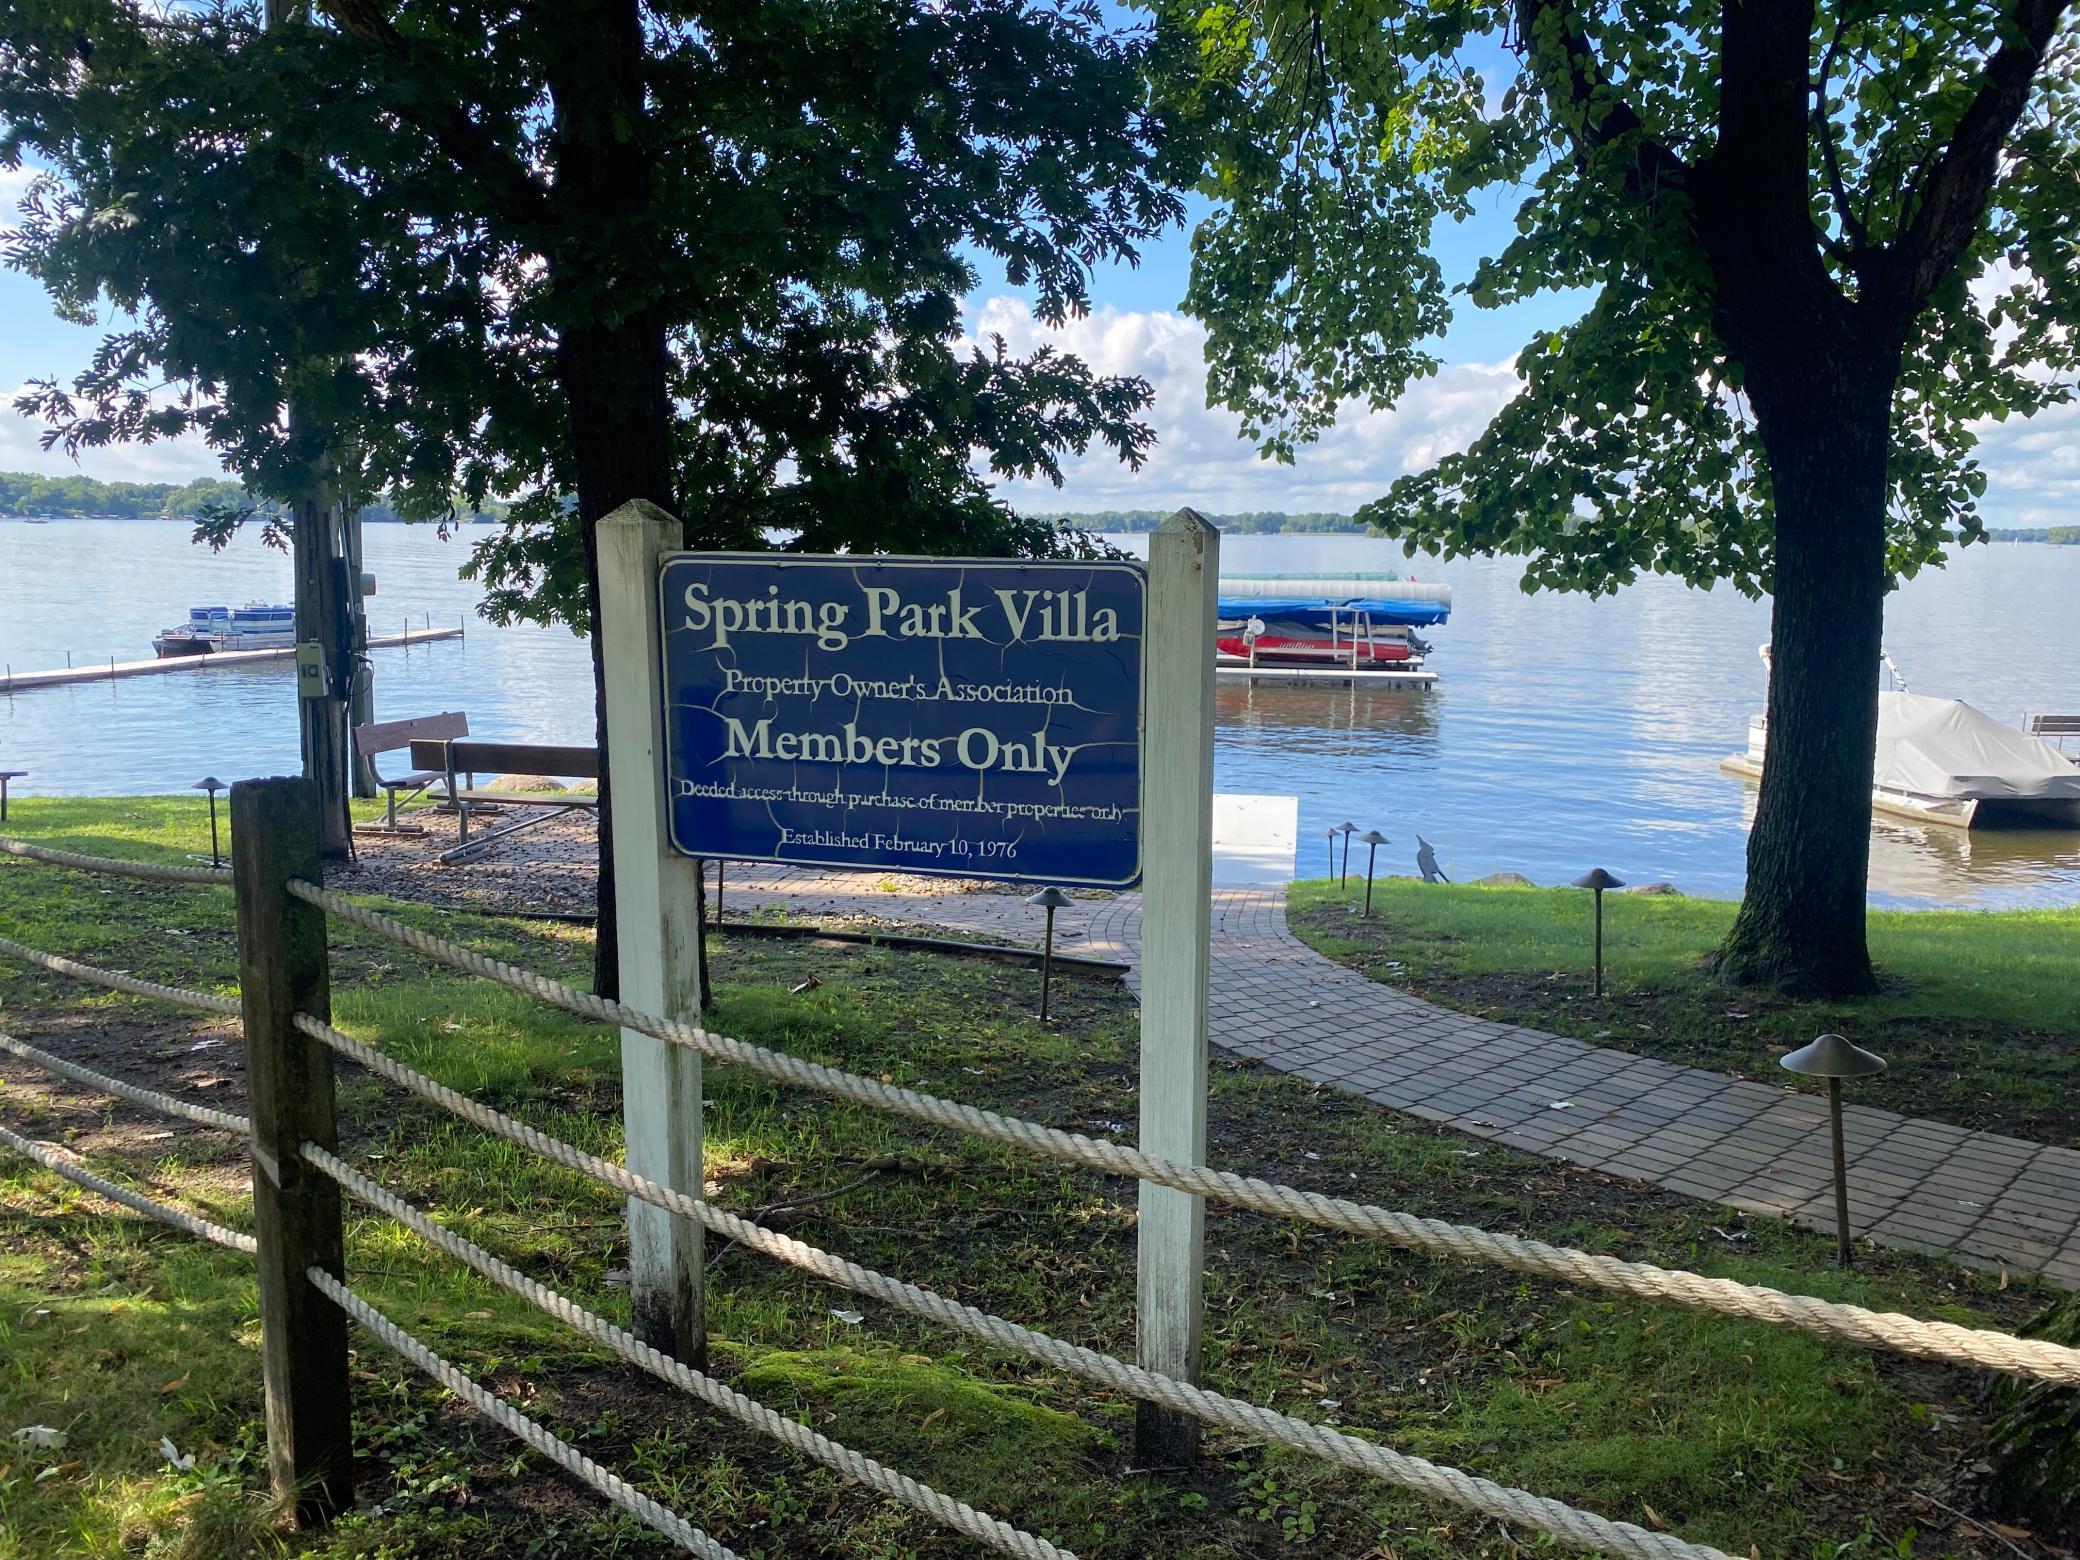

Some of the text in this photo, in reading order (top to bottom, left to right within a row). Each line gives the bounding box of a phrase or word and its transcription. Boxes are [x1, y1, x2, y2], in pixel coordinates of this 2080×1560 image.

[684, 582, 1120, 651] Spring Park Villa
[726, 670, 1074, 704] Property Owner's Association
[727, 719, 1076, 786] Members Only
[681, 780, 735, 799] Deeded
[740, 786, 783, 801] access
[787, 786, 845, 808] through
[849, 788, 915, 810] purchase
[919, 793, 938, 810] of
[939, 795, 1003, 813] member
[1007, 801, 1085, 819] properties
[783, 828, 1017, 859] Established February 10, 1976
